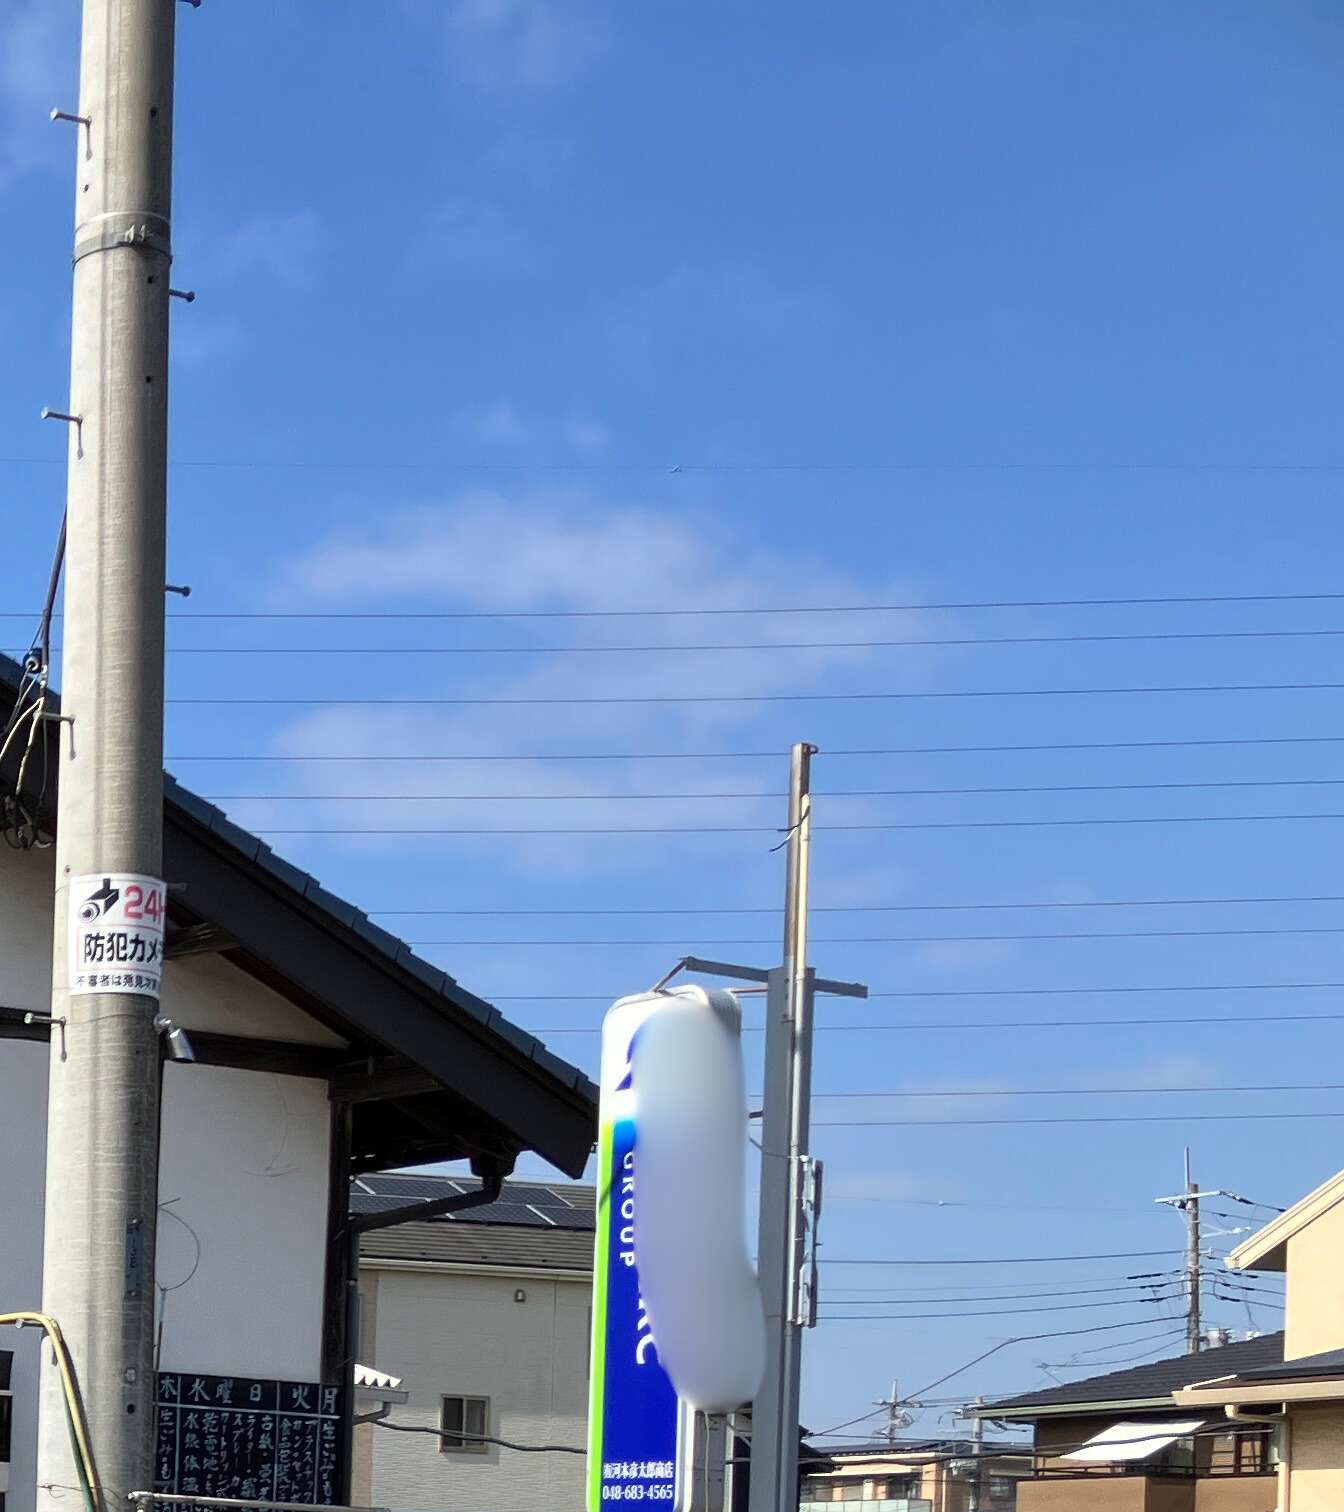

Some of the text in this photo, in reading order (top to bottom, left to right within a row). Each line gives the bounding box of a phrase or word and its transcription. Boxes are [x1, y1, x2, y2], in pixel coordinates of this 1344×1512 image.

[83, 932, 162, 964] 防犯カメ
[602, 1484, 674, 1500] 048-683-4565
